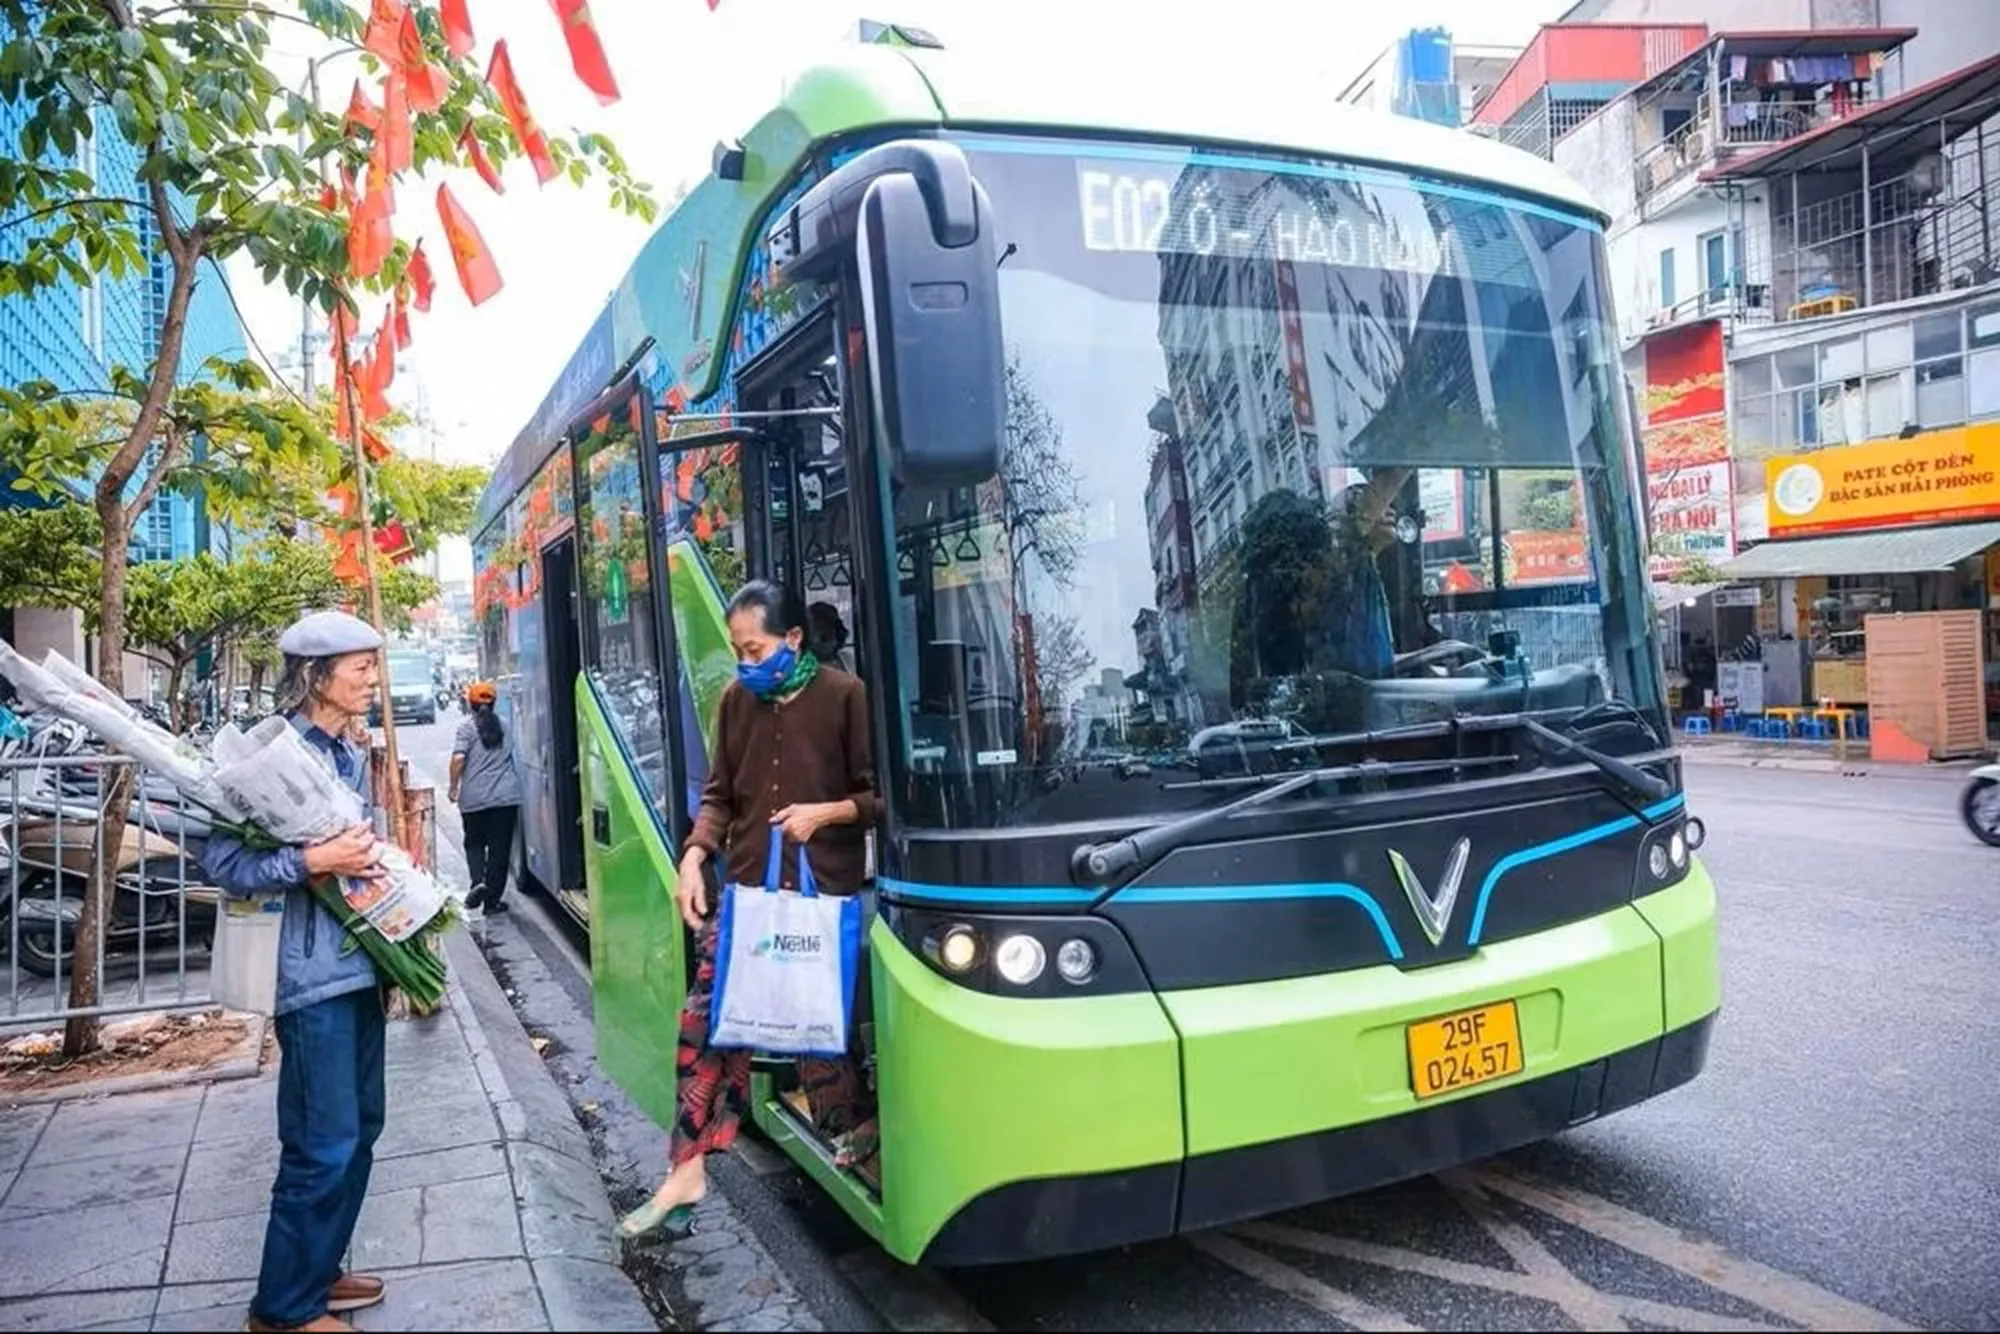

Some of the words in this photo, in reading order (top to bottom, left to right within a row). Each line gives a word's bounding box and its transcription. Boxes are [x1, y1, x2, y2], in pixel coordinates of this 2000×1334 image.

[1081, 171, 1170, 251] E02
[1843, 466, 1887, 483] PATE
[1891, 458, 1929, 478] CỘT
[1441, 1012, 1486, 1050] 29F
[1427, 1042, 1509, 1090] 024.57
